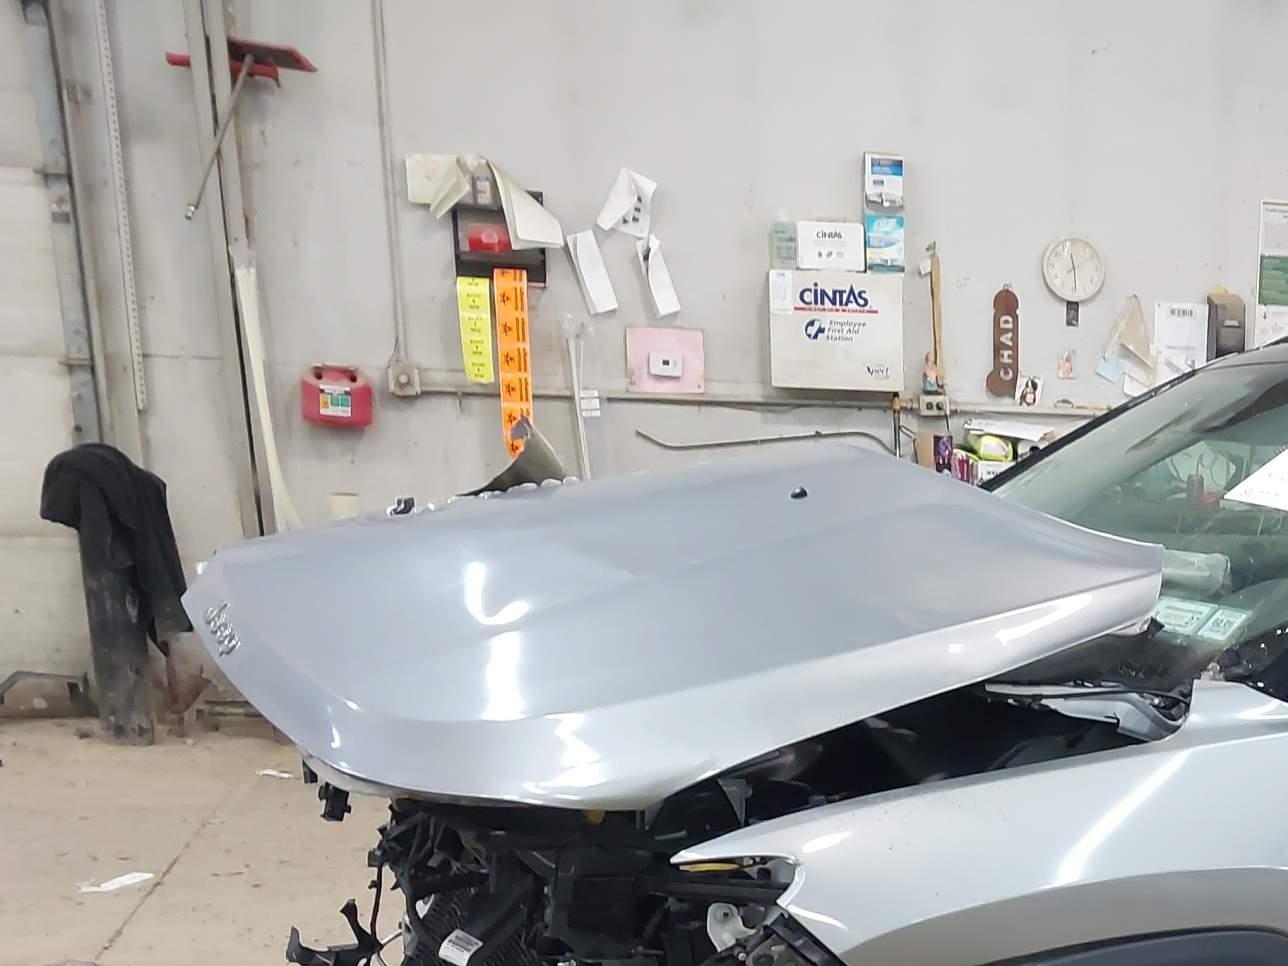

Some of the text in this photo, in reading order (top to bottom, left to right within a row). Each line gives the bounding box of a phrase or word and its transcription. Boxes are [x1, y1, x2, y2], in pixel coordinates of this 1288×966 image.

[799, 282, 869, 307] CINTAS
[829, 319, 867, 329] Employee
[828, 327, 860, 336] First Aid
[826, 334, 854, 343] Station
[999, 314, 1014, 381] CHAD
